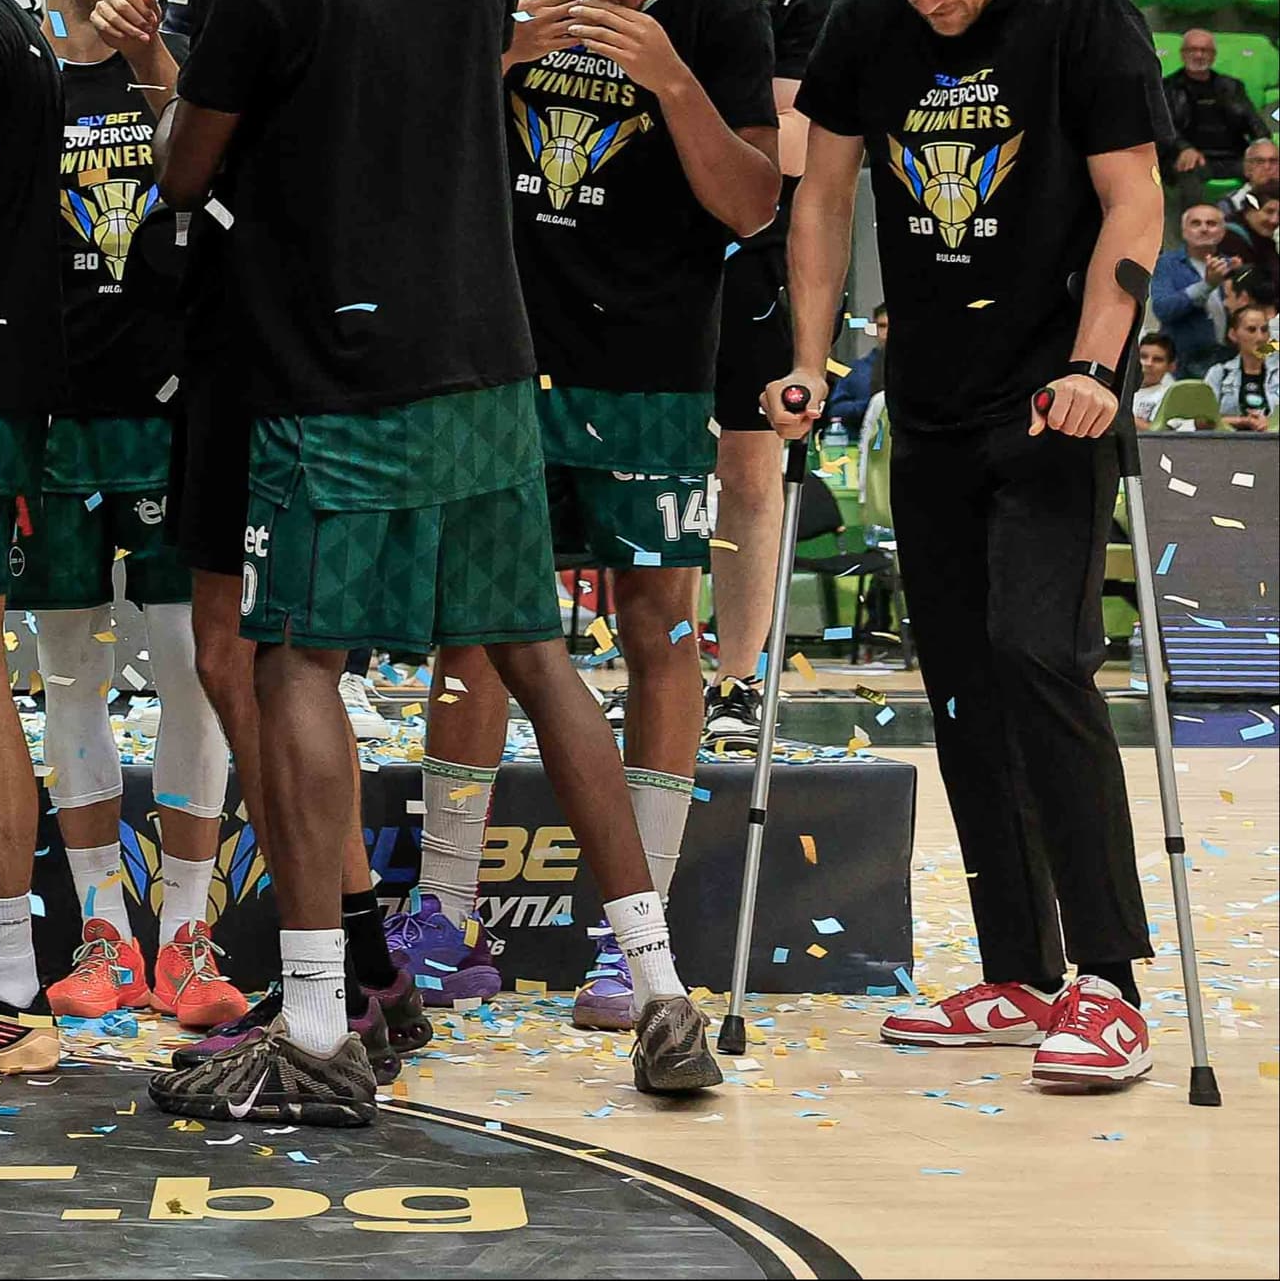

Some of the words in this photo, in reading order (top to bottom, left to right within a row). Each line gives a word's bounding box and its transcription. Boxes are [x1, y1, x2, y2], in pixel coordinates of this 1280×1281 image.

[523, 67, 637, 108] WINNERS
[919, 84, 999, 107] SUPERCUP
[77, 111, 142, 126] SLYBET
[903, 104, 1012, 133] WINNERS
[59, 145, 154, 174] WINNER
[515, 174, 542, 195] 20
[578, 185, 606, 206] 26
[536, 212, 577, 228] BULGARIA
[908, 216, 934, 235] 20
[974, 217, 998, 237] 26
[73, 253, 99, 270] 20
[657, 490, 710, 541] 14
